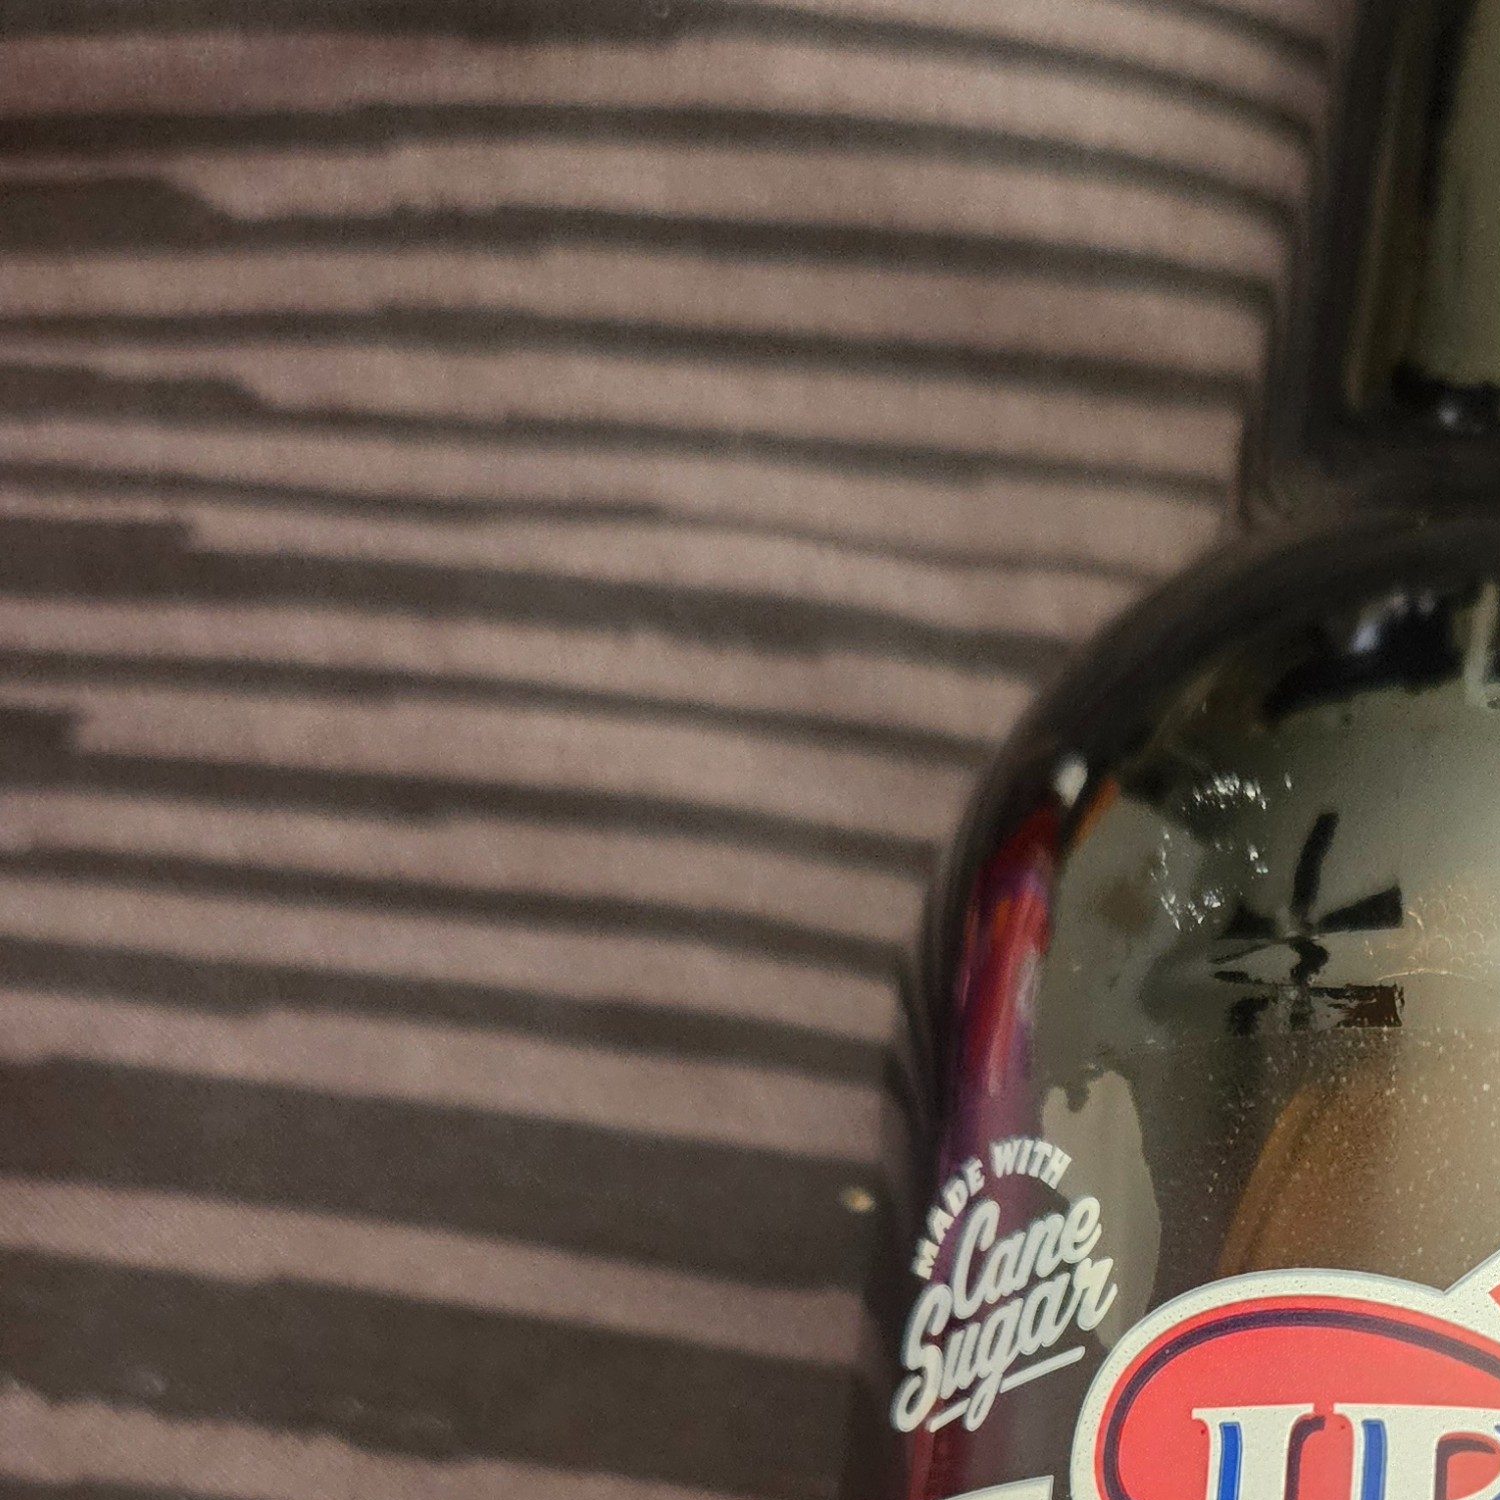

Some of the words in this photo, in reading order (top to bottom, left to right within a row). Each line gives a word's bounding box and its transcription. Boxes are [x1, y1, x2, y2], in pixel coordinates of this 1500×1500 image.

[911, 1157, 986, 1281] MADE
[989, 1136, 1073, 1190] WITH
[952, 1195, 1102, 1320] Cane
[890, 1256, 1119, 1433] Sugar
